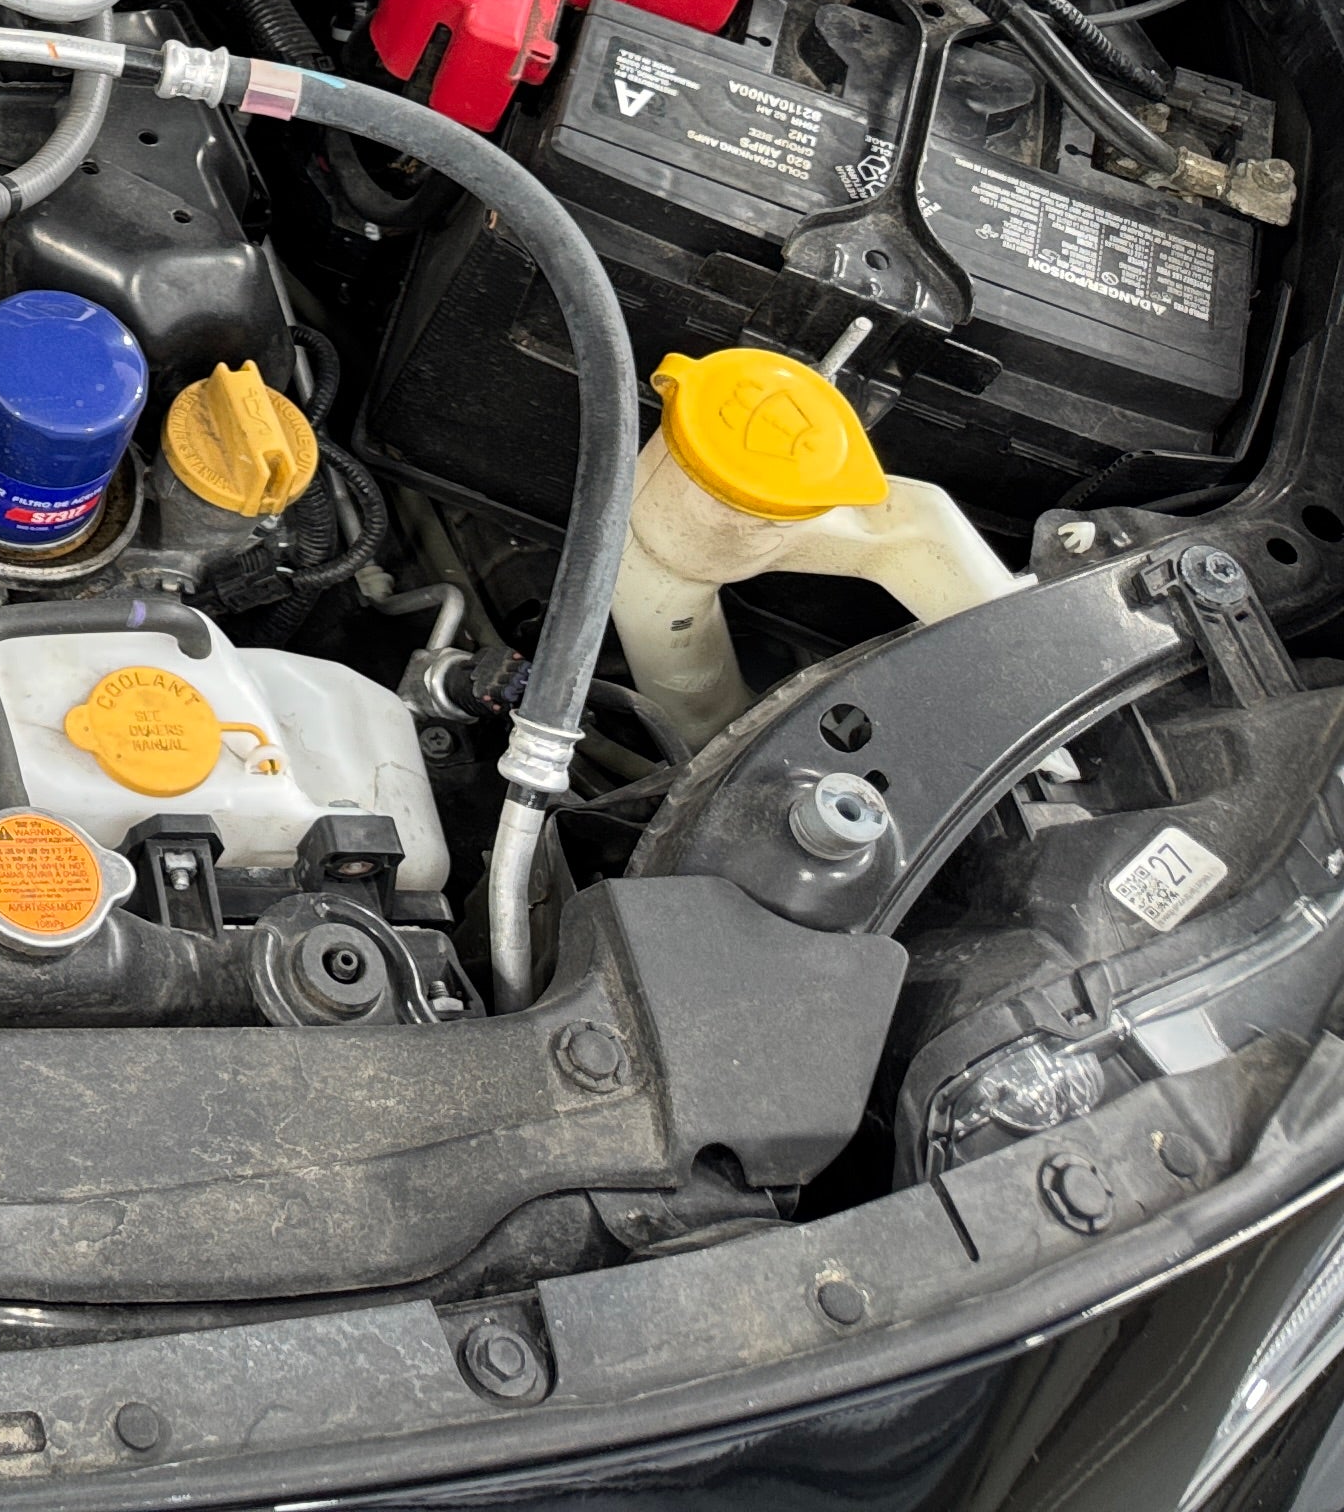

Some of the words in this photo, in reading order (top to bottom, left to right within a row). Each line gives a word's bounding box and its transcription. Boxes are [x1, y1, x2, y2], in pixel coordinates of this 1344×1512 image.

[613, 78, 655, 117] A
[726, 78, 823, 123] 82110AN00A
[685, 127, 719, 148] AMPS
[746, 125, 774, 143] SIZE
[786, 126, 818, 147] LN2
[718, 139, 778, 170] CRANKING
[737, 134, 782, 160] AMPS
[773, 135, 815, 158] GROUP
[776, 161, 810, 181] COLD
[784, 151, 813, 170] 620
[1025, 256, 1152, 311] DANGER/POISON
[12, 495, 52, 508] FILTRO
[53, 500, 70, 508] DE
[97, 672, 200, 710] COOLANT
[14, 828, 62, 836] WARNING
[15, 863, 37, 871] OPEN
[1150, 843, 1193, 887] 27
[8, 902, 82, 912] AVERTISSEMENT
